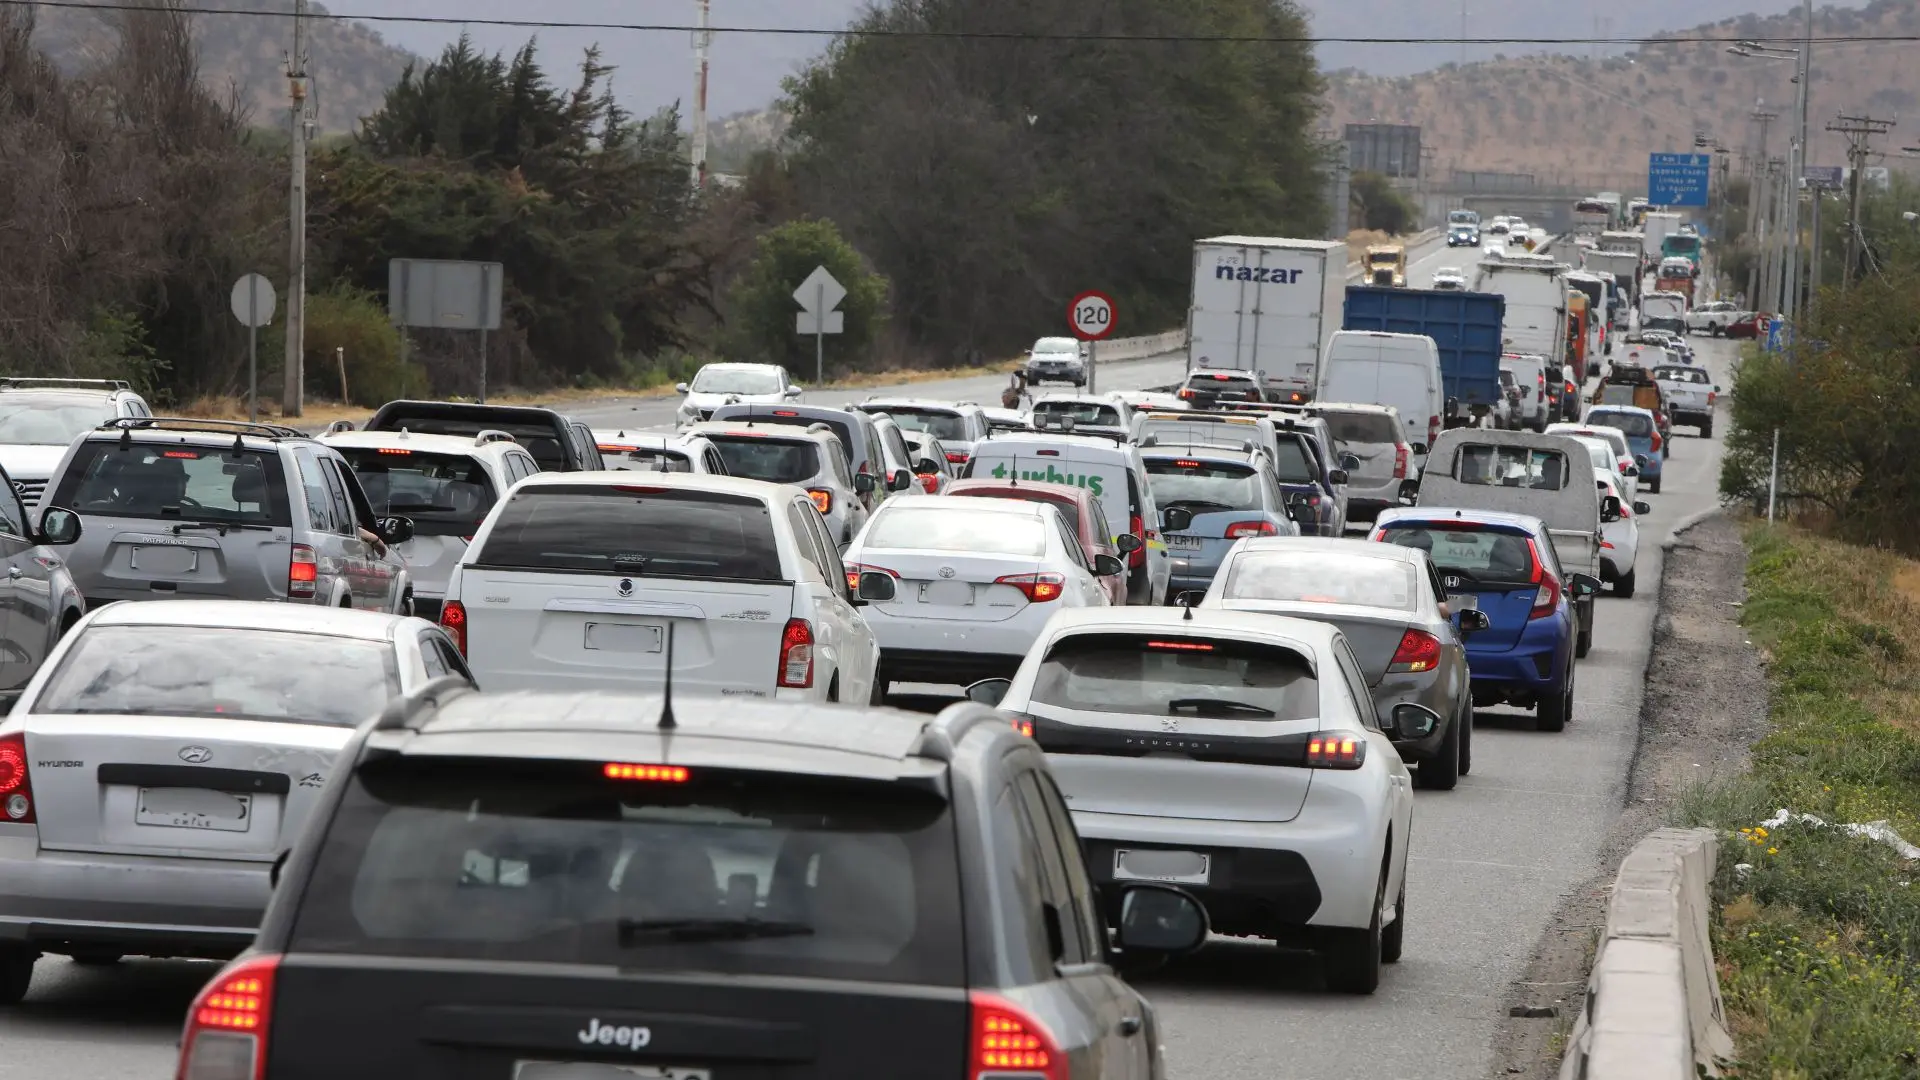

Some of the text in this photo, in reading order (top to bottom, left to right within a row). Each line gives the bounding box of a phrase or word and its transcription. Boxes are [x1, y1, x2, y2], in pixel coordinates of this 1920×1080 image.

[1216, 265, 1304, 284] nazar
[1077, 307, 1108, 324] 120
[142, 536, 188, 546] PATHFINDER
[1126, 738, 1211, 750] PEUGEOT
[38, 760, 84, 768] HYUNDAI
[577, 1018, 651, 1051] Jeep
